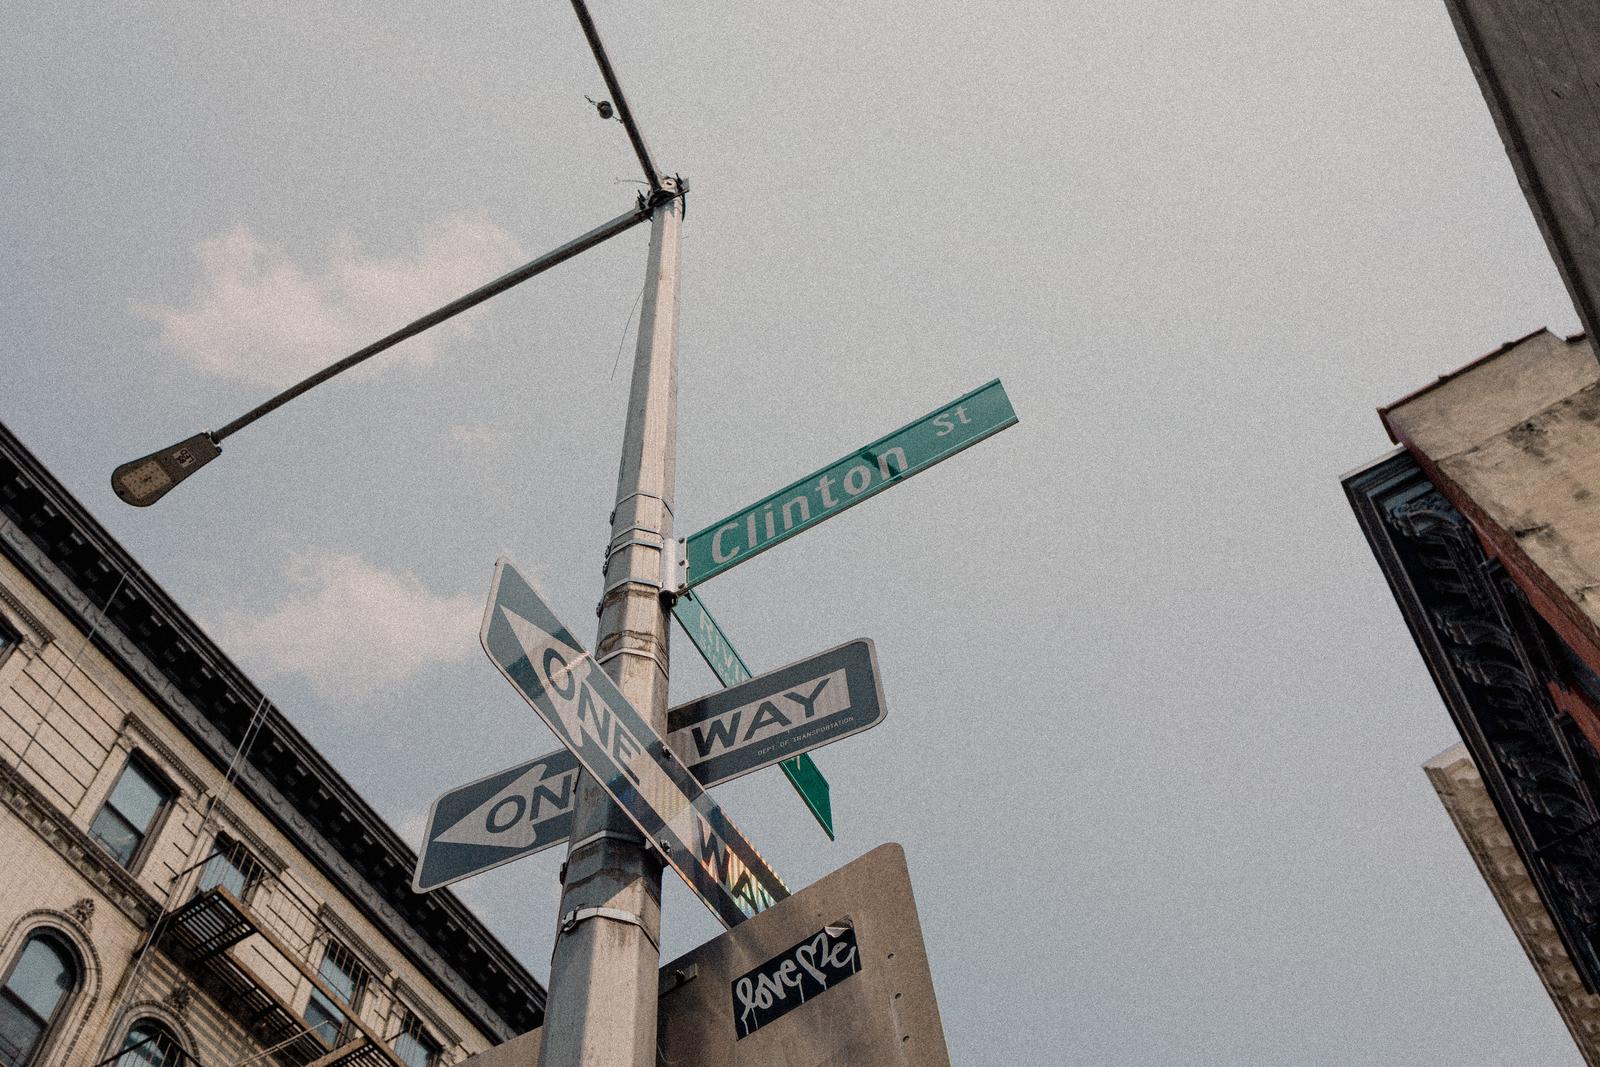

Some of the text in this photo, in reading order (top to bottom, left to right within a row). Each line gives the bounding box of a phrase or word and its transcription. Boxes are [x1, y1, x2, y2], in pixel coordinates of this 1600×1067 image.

[180, 449, 194, 464] LED
[710, 404, 972, 565] Clinton St
[486, 677, 832, 834] ON WAY
[543, 647, 769, 916] ONE WA
[757, 716, 854, 756] DEPT OF TRANSPORTATION
